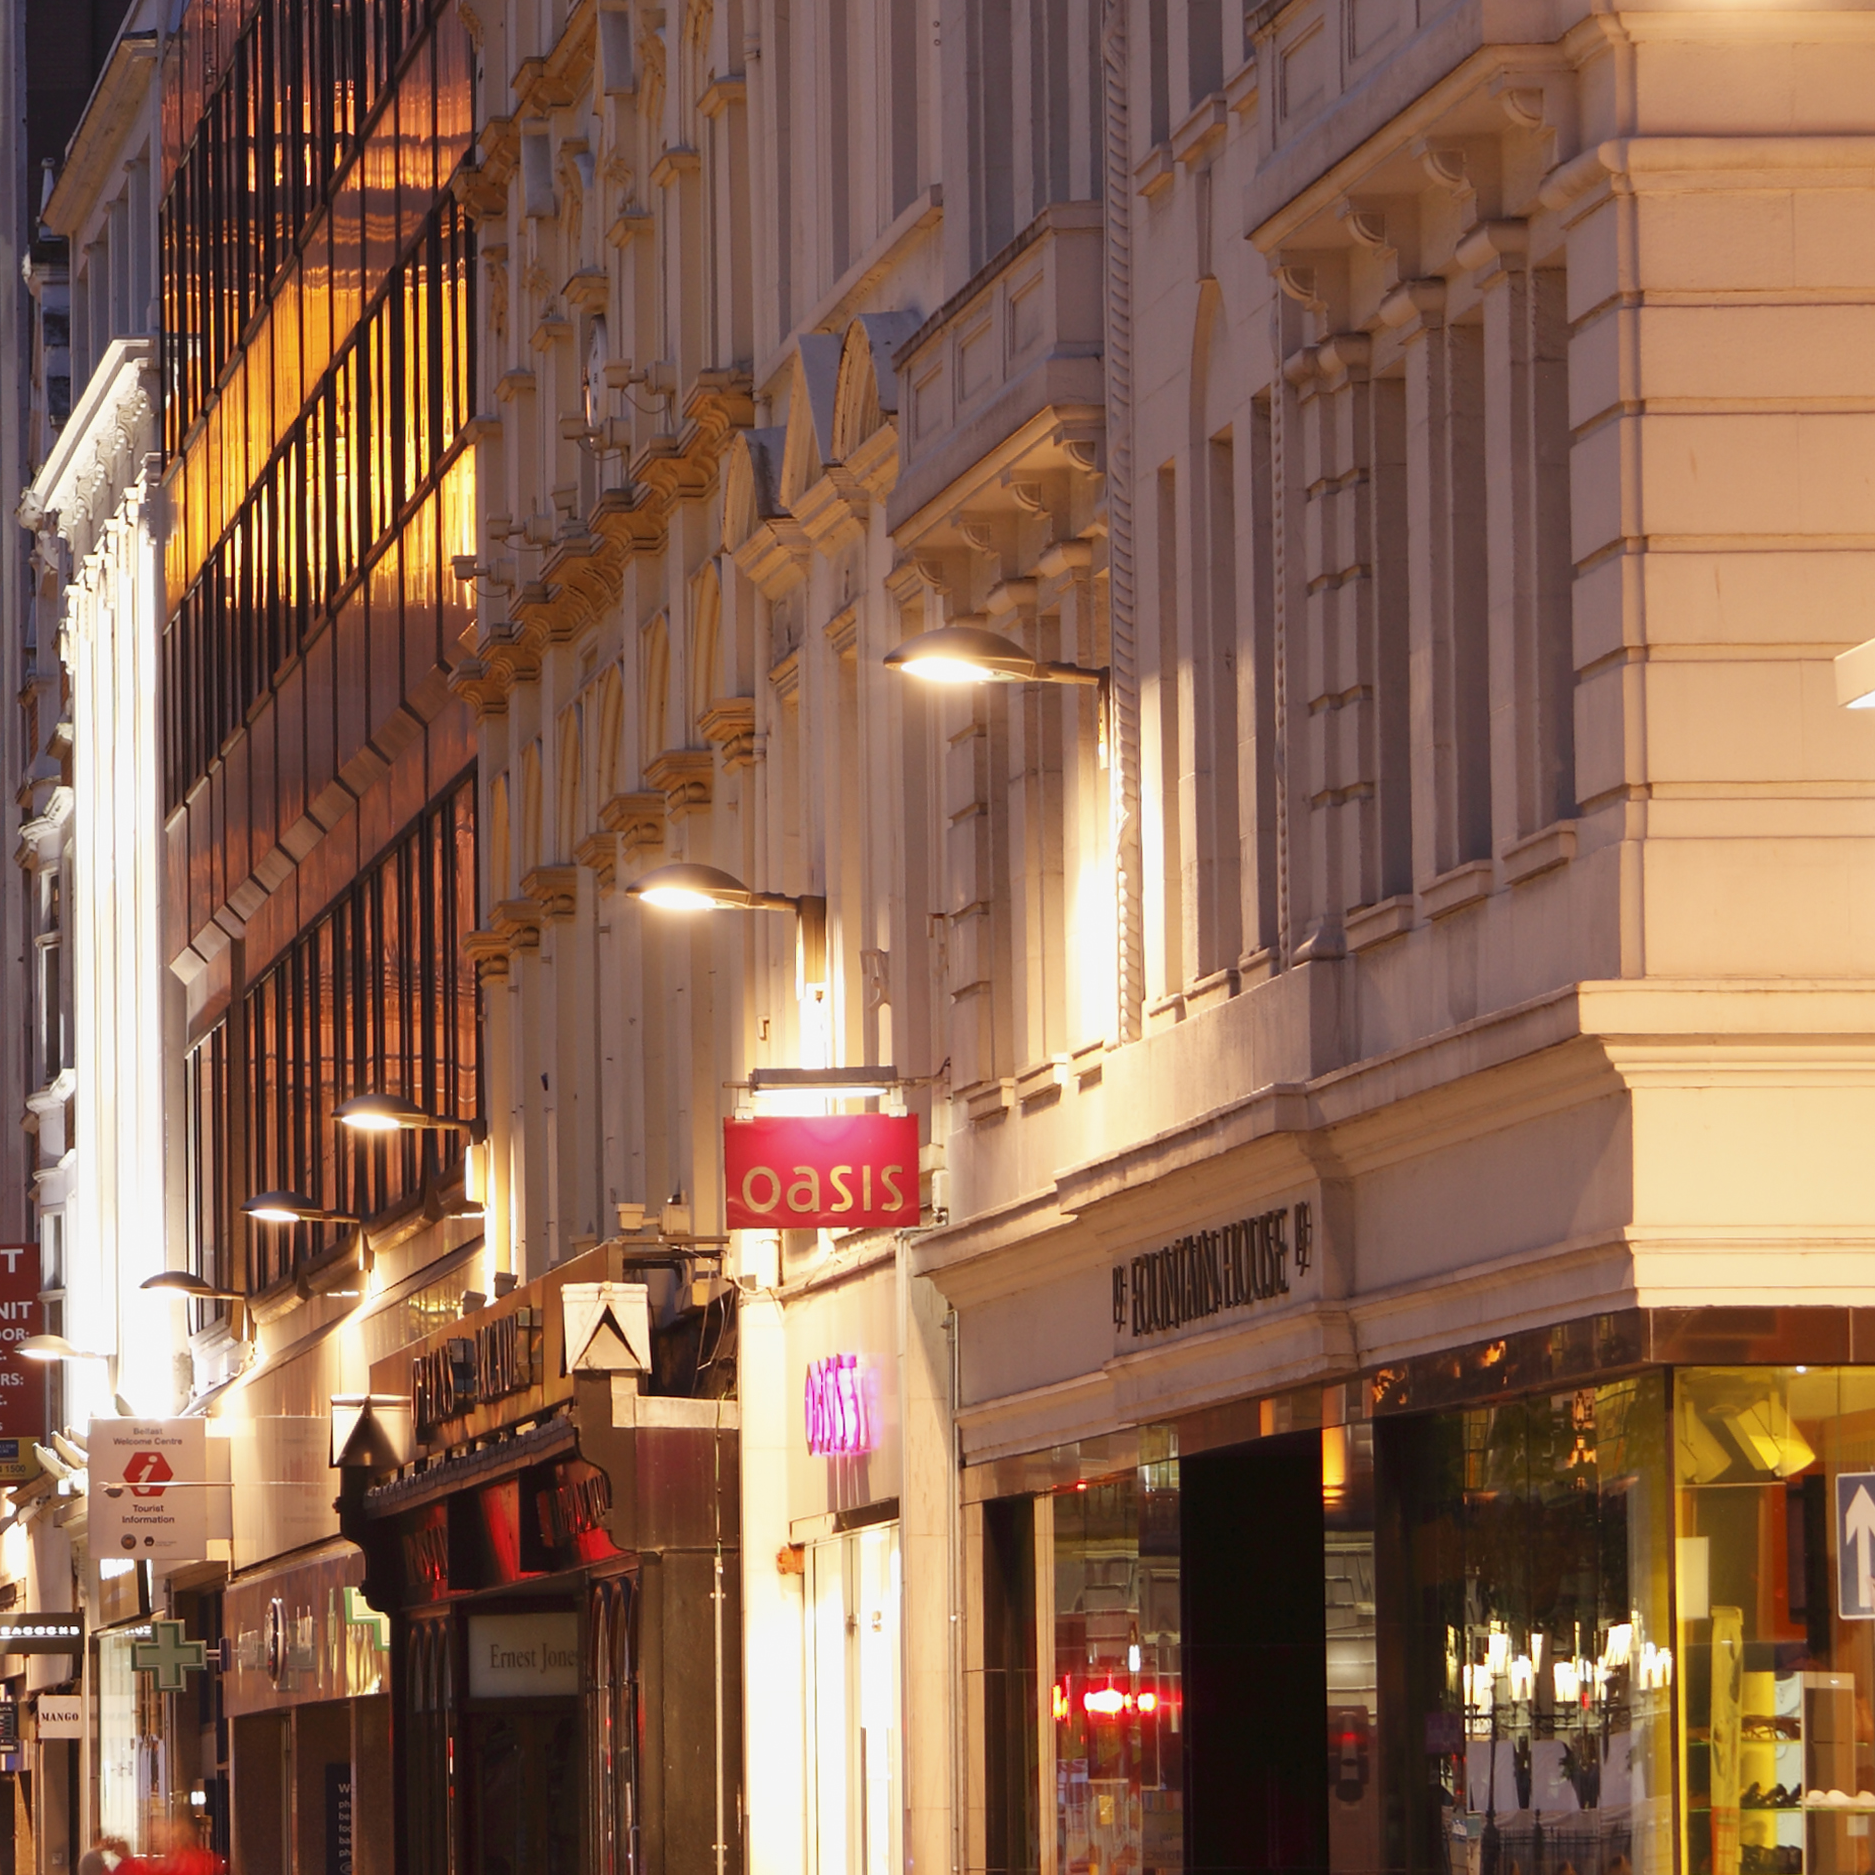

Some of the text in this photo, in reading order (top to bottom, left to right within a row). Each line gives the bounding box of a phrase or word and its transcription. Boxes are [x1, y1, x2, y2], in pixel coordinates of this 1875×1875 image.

[1222, 1208, 1290, 1308] HOUSE
[132, 1504, 164, 1513] Tourist
[122, 1516, 175, 1524] Information
[490, 1642, 578, 1674] Ernest Jone
[41, 1711, 79, 1722] MANGO
